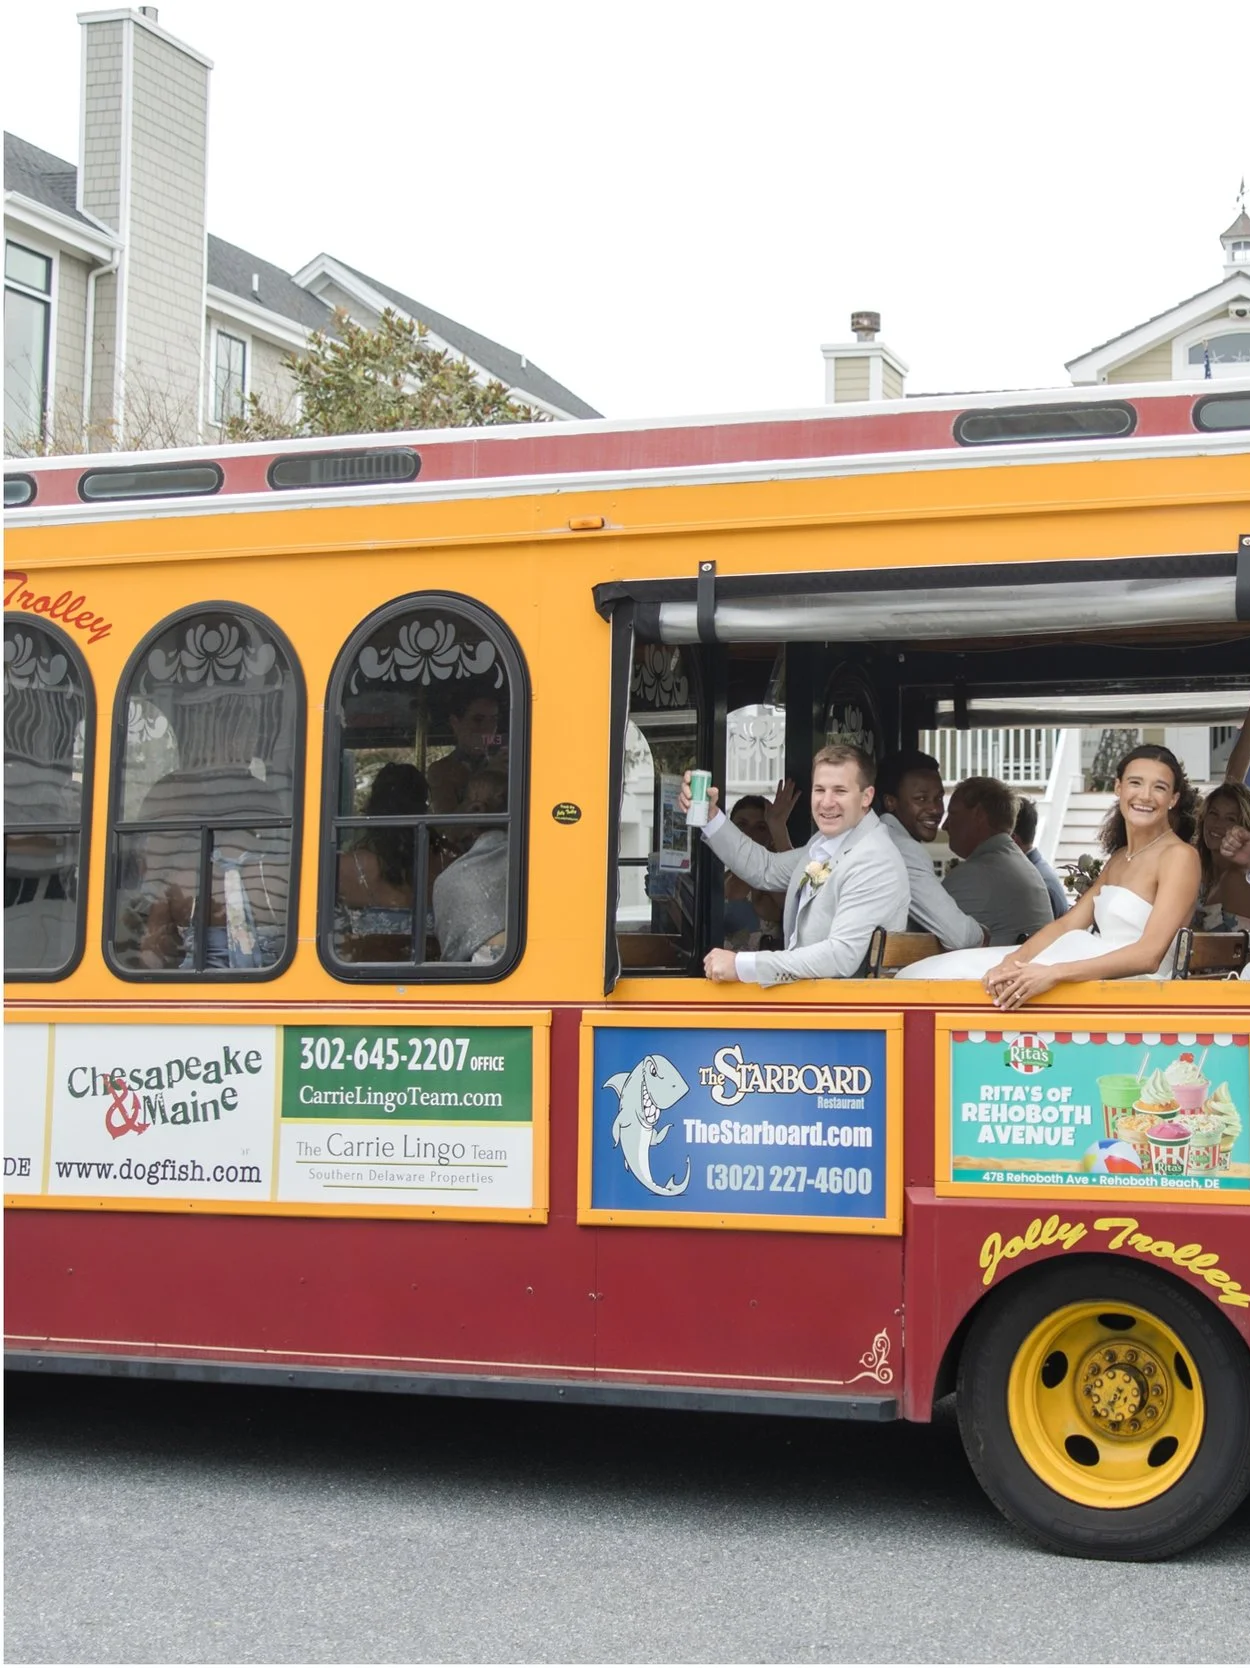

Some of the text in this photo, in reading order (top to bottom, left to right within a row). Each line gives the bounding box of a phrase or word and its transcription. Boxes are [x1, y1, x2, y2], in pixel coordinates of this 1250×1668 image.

[4, 569, 113, 645] Trolley
[299, 1037, 505, 1073] 302-645-2207 OFFICE
[67, 1045, 263, 1100] Chesapeake
[699, 1066, 725, 1087] The
[104, 1073, 151, 1141] &
[140, 1086, 239, 1127] Maine
[299, 1085, 504, 1113] CarrieLingoTeam.com
[817, 1096, 865, 1110] Restaurant
[979, 1084, 1072, 1104] RITA'S OF
[961, 1102, 1092, 1126] REHOBOTH
[683, 1118, 873, 1147] TheStarboard.com
[977, 1125, 1077, 1146] AVENUE
[296, 1132, 508, 1166] The Carrie Lingo Team
[3, 1157, 31, 1177] DE
[55, 1157, 262, 1185] www.dogfish.com
[308, 1167, 494, 1186] Southern Delaware Properties
[706, 1163, 873, 1195] (302) 227-4600
[982, 1171, 1220, 1190] 47B Rehoboth Ave Rehoboth Beach, DE
[979, 1214, 1088, 1286] Jolly
[1094, 1217, 1250, 1308] Trolley
